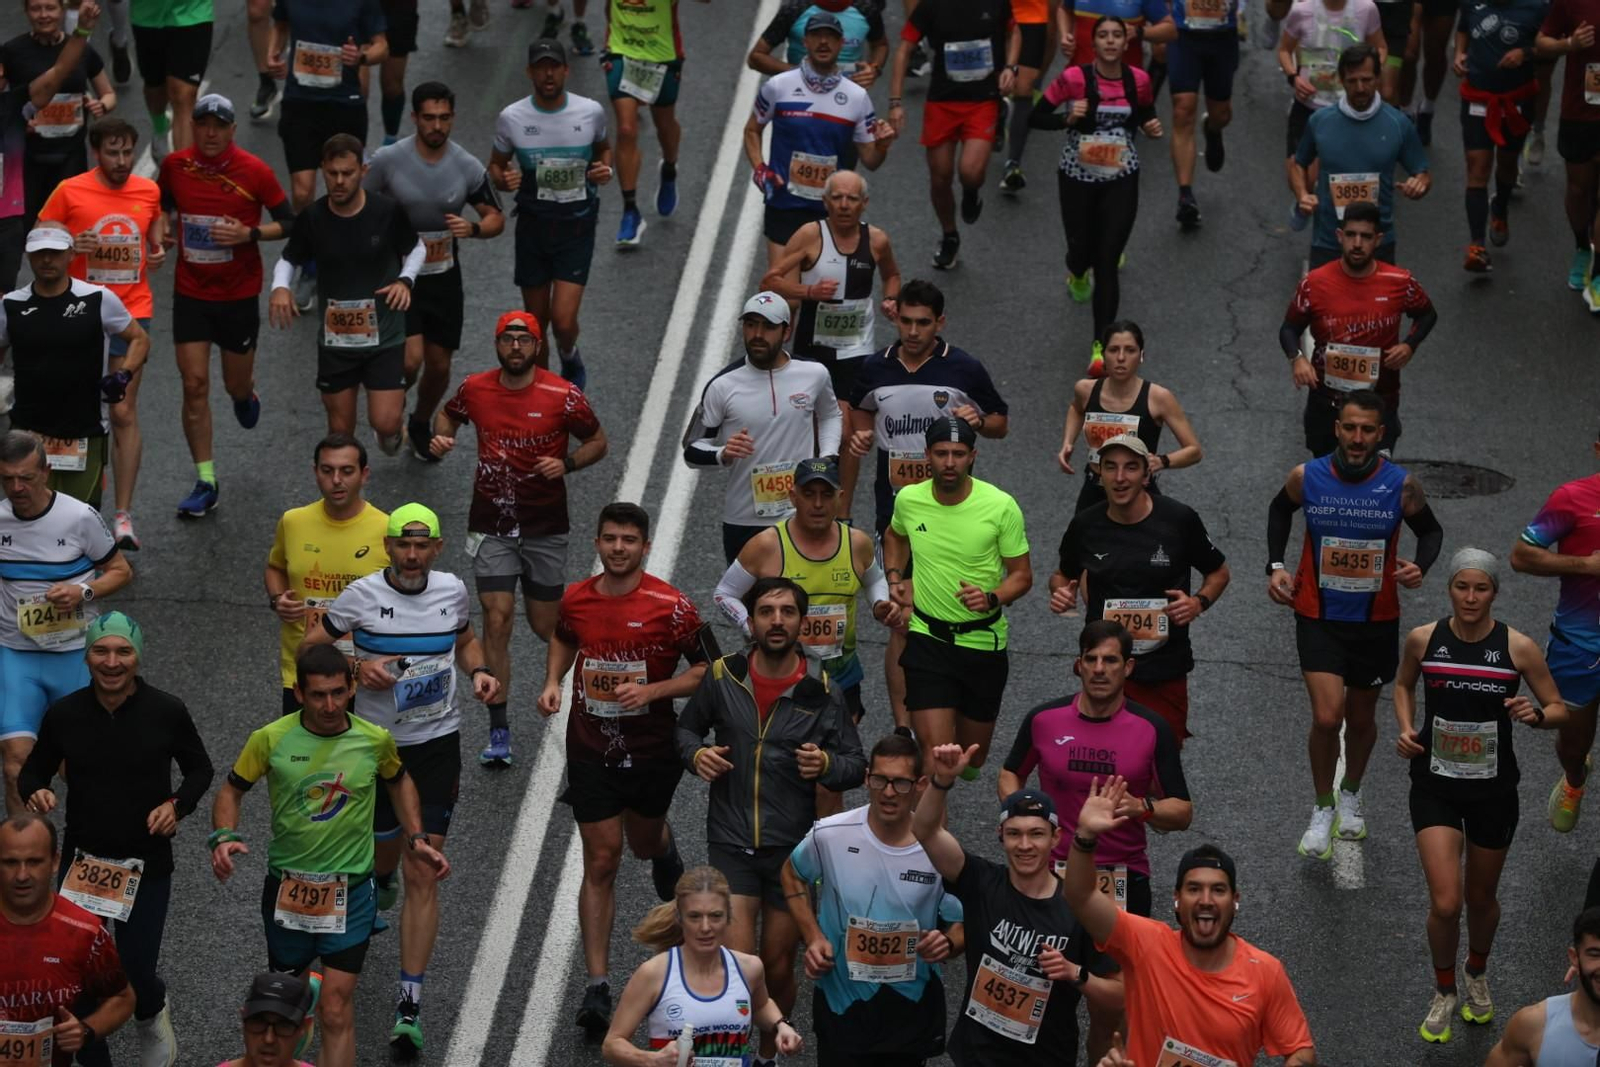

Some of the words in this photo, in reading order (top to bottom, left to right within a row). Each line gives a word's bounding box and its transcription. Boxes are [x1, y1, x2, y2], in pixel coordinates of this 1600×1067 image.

[544, 169, 575, 184] 6831
[796, 163, 828, 182] 4913
[1336, 185, 1368, 200] 3895
[95, 246, 131, 262] 4403
[331, 312, 365, 327] 3825
[824, 315, 857, 329] 6732
[1333, 356, 1367, 374] 3816
[884, 413, 934, 439] Quilme
[1320, 495, 1380, 507] FUNDACIÓN
[1307, 506, 1336, 516] JOSEP
[1338, 508, 1394, 519] CARRERAS
[1331, 551, 1370, 570] 5435
[304, 577, 347, 593] SEVIL
[403, 681, 440, 701] 2243
[1440, 731, 1482, 755] 7786
[77, 863, 123, 890] 3826
[288, 883, 330, 910] 4197
[856, 933, 902, 955] 3852
[983, 978, 1030, 1010] 4537
